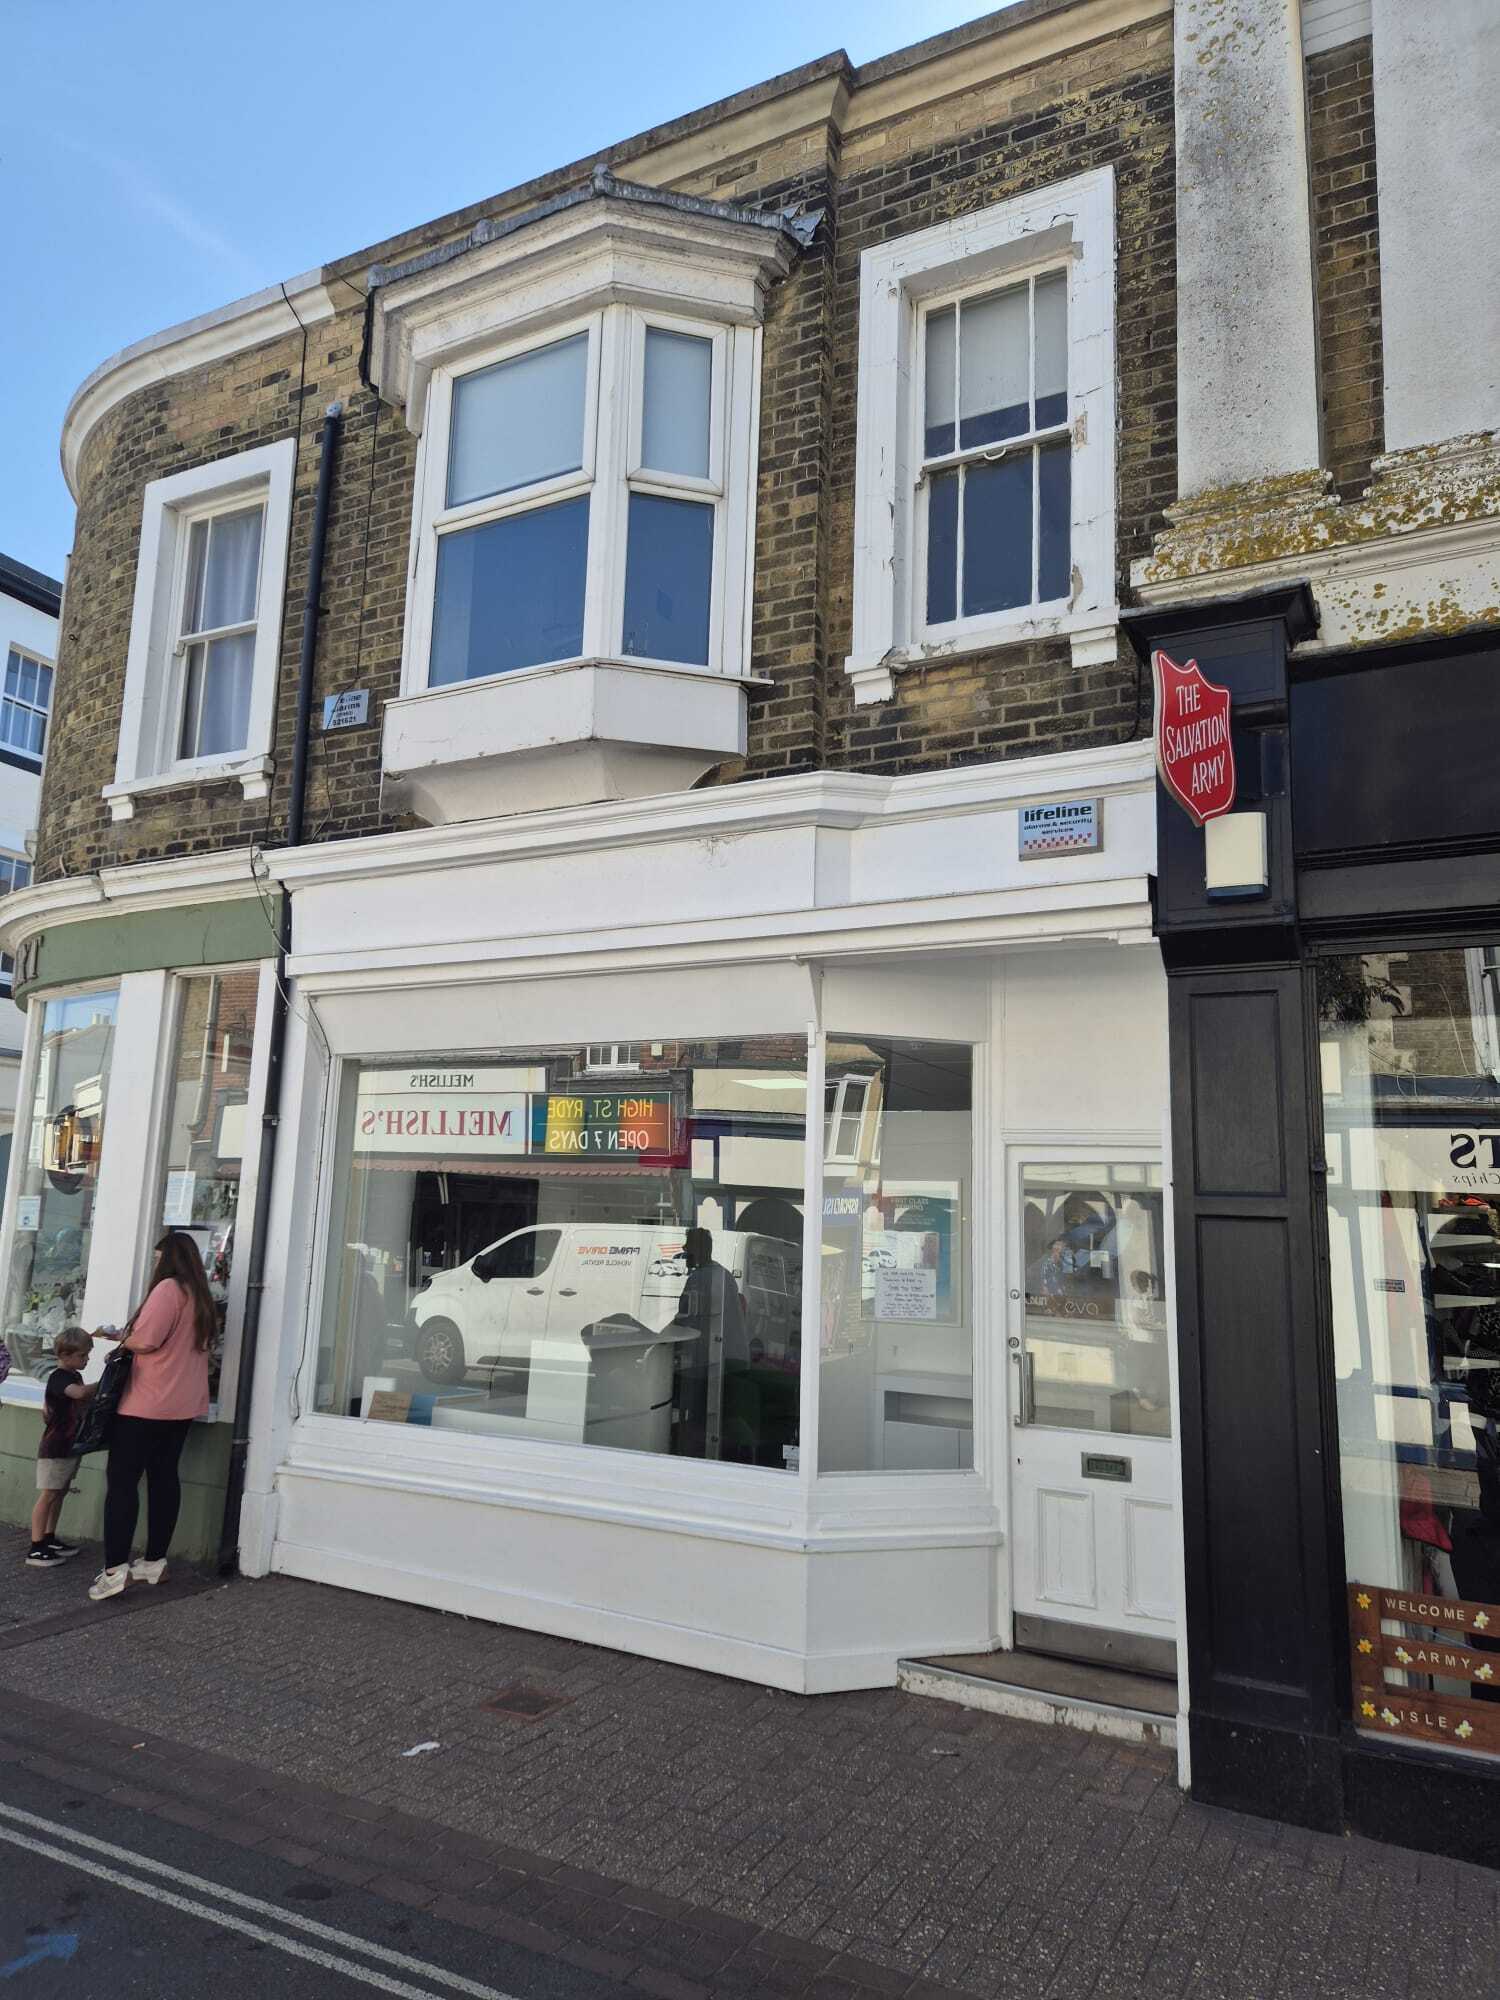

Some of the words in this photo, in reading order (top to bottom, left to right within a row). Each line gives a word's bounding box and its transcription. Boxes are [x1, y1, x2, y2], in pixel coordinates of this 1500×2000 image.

[1175, 683, 1201, 716] THE
[1166, 707, 1228, 765] SALVATION
[1191, 750, 1226, 797] ARMY
[1024, 805, 1092, 822] lifeline
[1059, 817, 1092, 826] security
[1041, 827, 1074, 835] services
[1385, 1597, 1465, 1621] WELCOME
[1417, 1650, 1472, 1669] ARMY
[1400, 1710, 1448, 1728] ISLE
